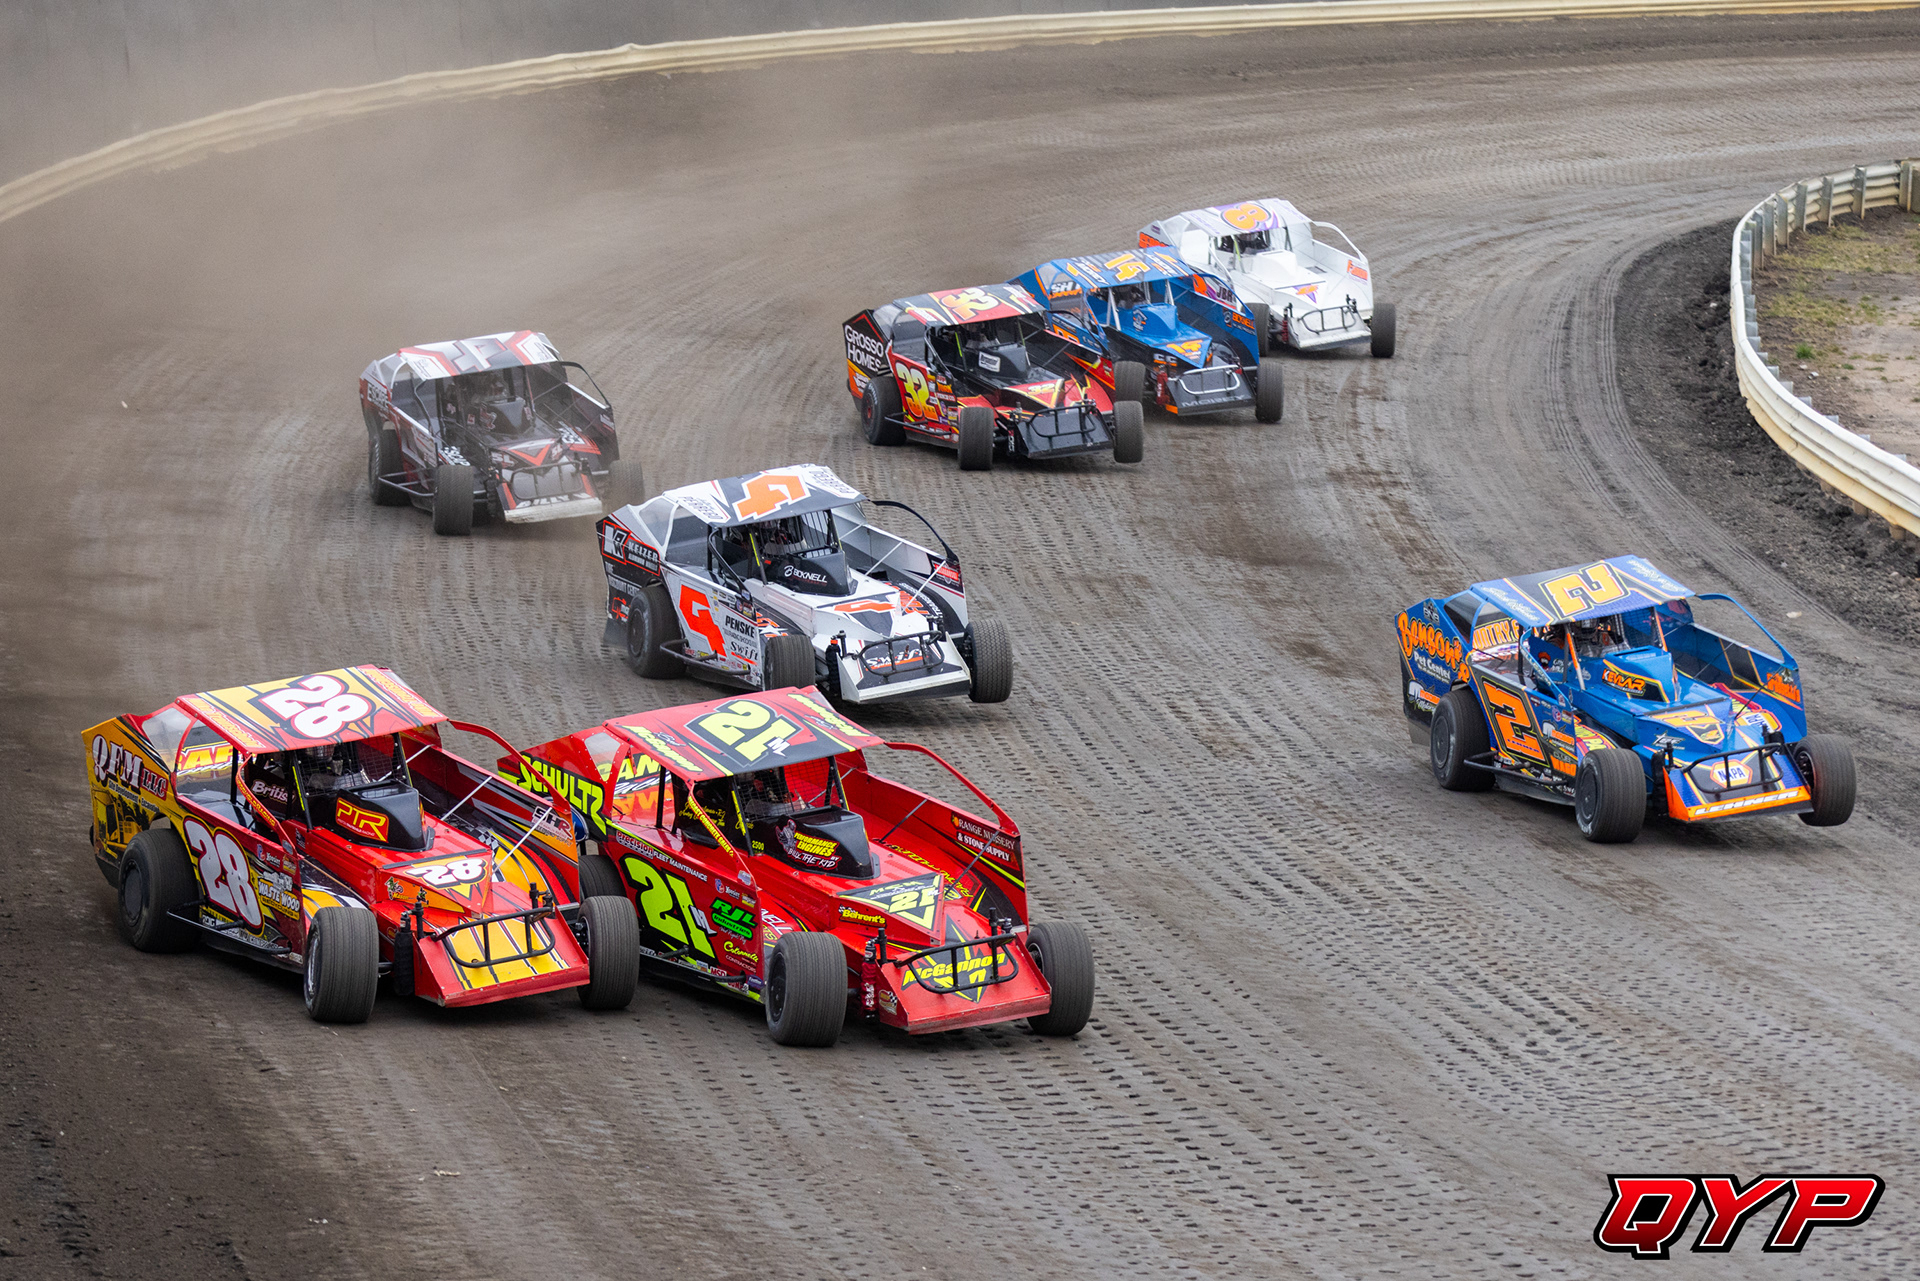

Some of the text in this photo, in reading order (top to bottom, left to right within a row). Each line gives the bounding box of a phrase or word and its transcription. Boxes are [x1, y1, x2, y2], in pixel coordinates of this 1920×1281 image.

[1105, 253, 1150, 282] 14
[940, 287, 999, 321] 32
[844, 324, 884, 358] GROSSO
[1166, 339, 1203, 354] 14
[847, 342, 882, 372] HOMES
[895, 362, 939, 421] 32
[737, 475, 806, 518] 4
[628, 541, 658, 563] KEIZER
[1546, 564, 1623, 615] 2
[679, 584, 727, 658] 4
[725, 615, 755, 638] PENSKE
[731, 641, 759, 661] Swift
[1602, 668, 1647, 691] KEVLAR
[259, 675, 370, 738] 28
[1483, 681, 1546, 761] 2
[92, 734, 143, 789] QFM
[142, 768, 167, 798] LLC
[1716, 767, 1747, 783] NAPA
[519, 754, 607, 836] SCHULTZ
[1694, 790, 1800, 816] LEHNER
[337, 799, 388, 842] PTR
[616, 830, 708, 882] Precision FLEET MAINTENANCE
[797, 840, 835, 857] ENGINES
[802, 852, 821, 865] THE
[818, 859, 836, 868] KID
[957, 832, 1011, 862] & STONE SUPPLY
[184, 819, 263, 926] 28
[405, 858, 485, 887] 28
[258, 881, 281, 903] WASTE
[280, 890, 300, 912] WOOD
[712, 899, 757, 927] RJL
[714, 914, 751, 936] Industries
[843, 909, 886, 925] Behrent's
[711, 967, 727, 976] MSD
[902, 953, 1006, 988] McGannon
